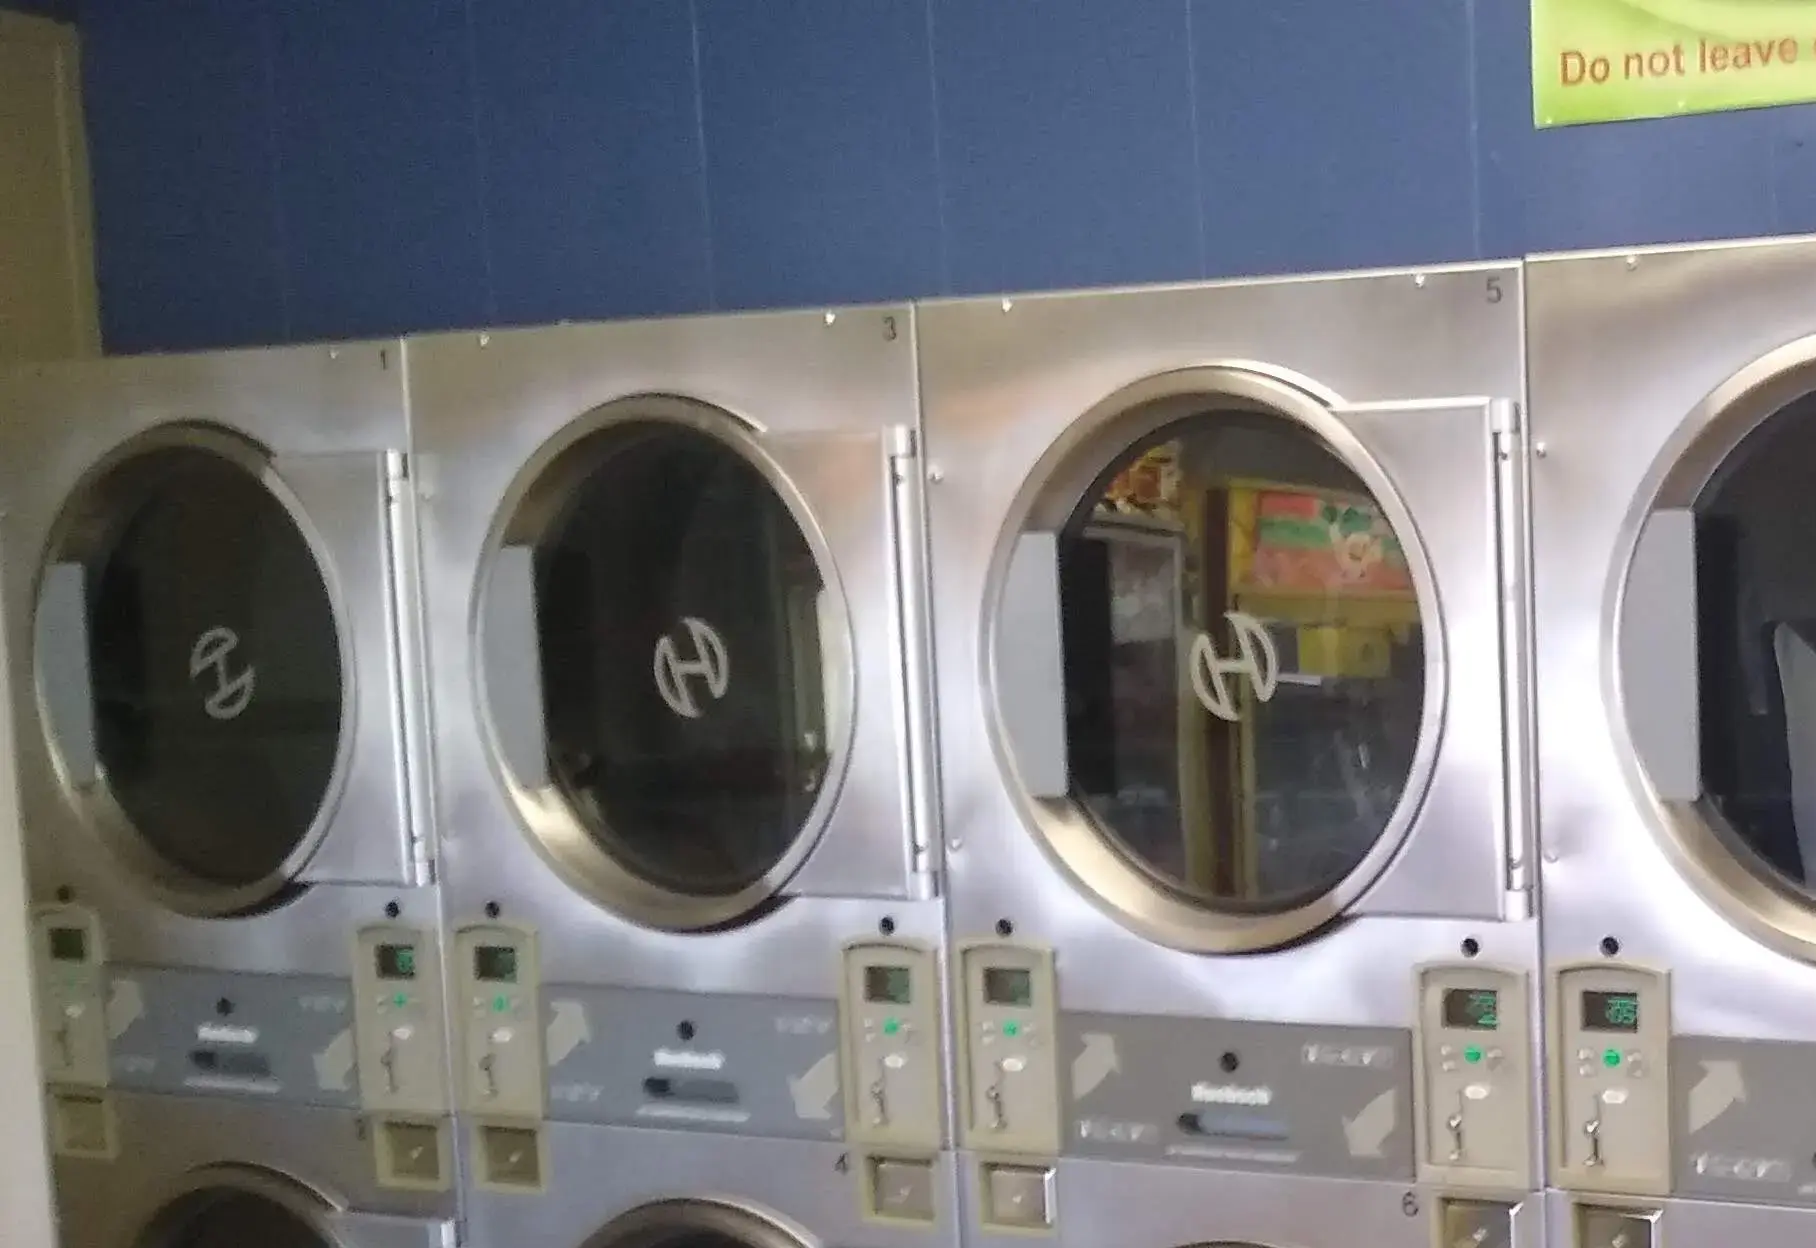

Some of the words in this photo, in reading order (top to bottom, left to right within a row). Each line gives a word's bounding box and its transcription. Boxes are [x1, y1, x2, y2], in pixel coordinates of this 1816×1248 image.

[1559, 50, 1610, 86] Do
[1623, 45, 1686, 79] not
[1699, 39, 1799, 73] leave
[1486, 276, 1504, 304] 5
[1402, 1190, 1419, 1218] 6
